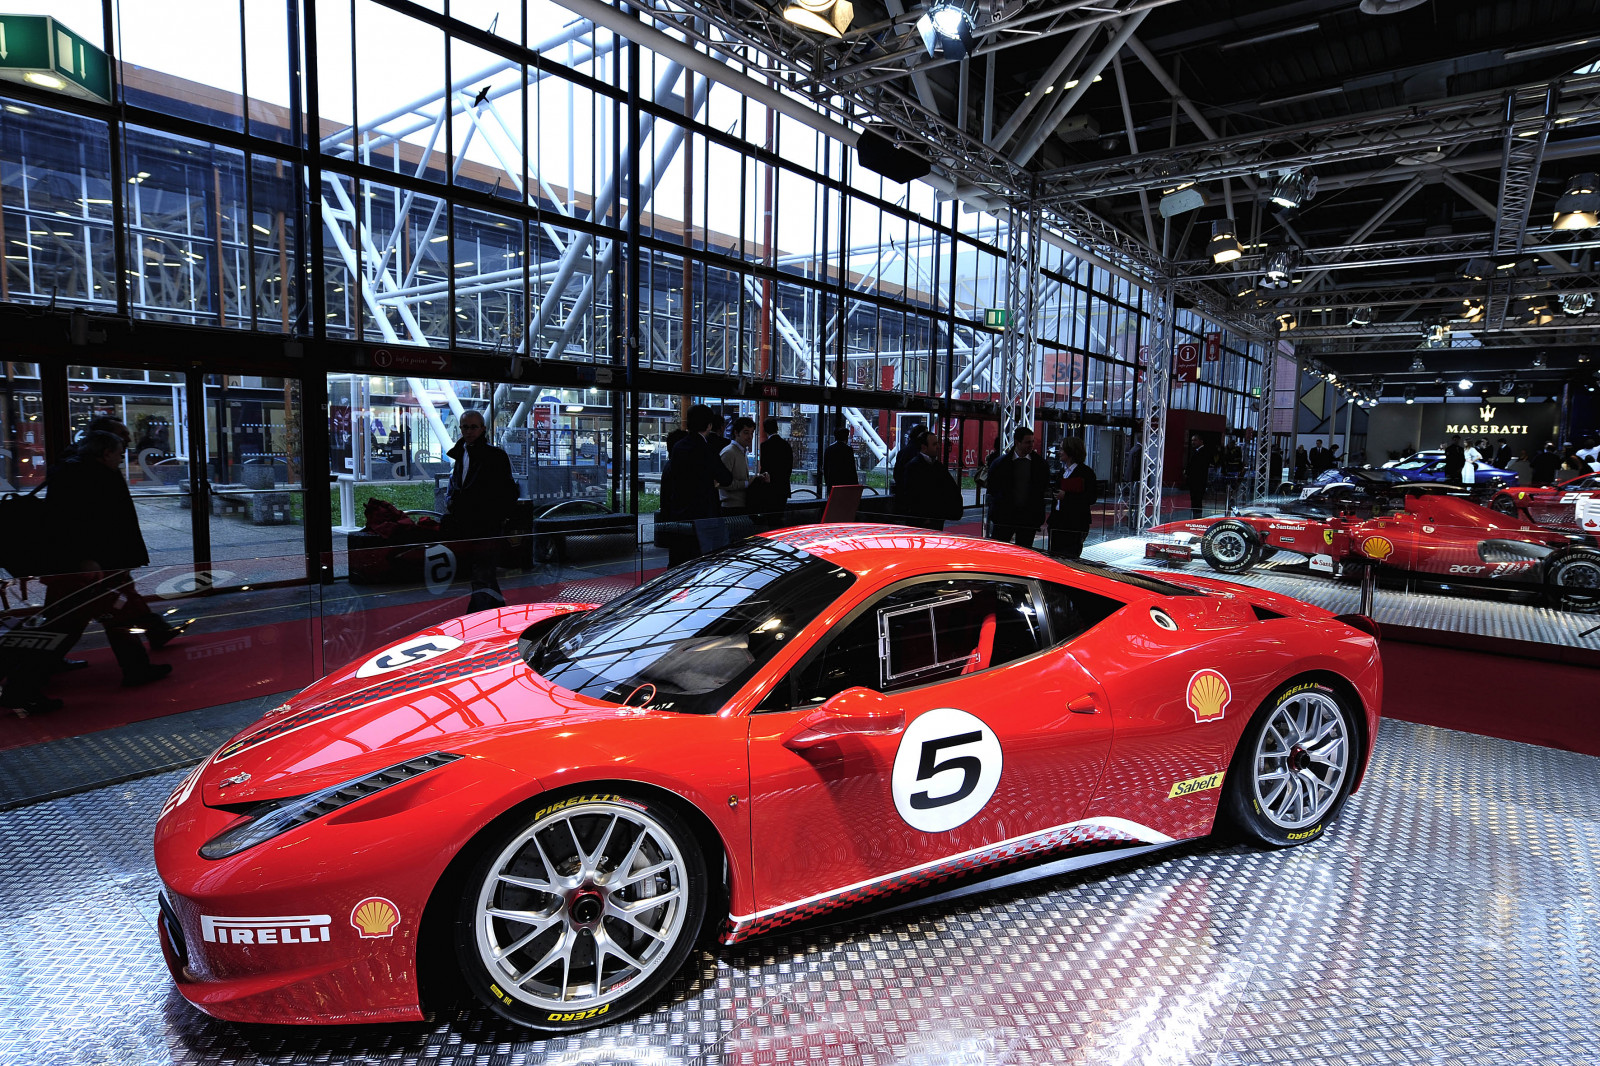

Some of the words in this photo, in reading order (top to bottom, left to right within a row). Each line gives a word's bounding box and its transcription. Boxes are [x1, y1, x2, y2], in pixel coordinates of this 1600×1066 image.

[1446, 424, 1528, 434] MASERATI
[1275, 523, 1306, 531] Santander
[1449, 564, 1486, 574] acer
[376, 643, 449, 668] 5
[1277, 683, 1313, 706] PIRELLI
[910, 730, 982, 810] 5
[1175, 775, 1218, 795] Sabelt
[535, 794, 610, 820] PIRELLI
[200, 914, 332, 944] PIRELLI
